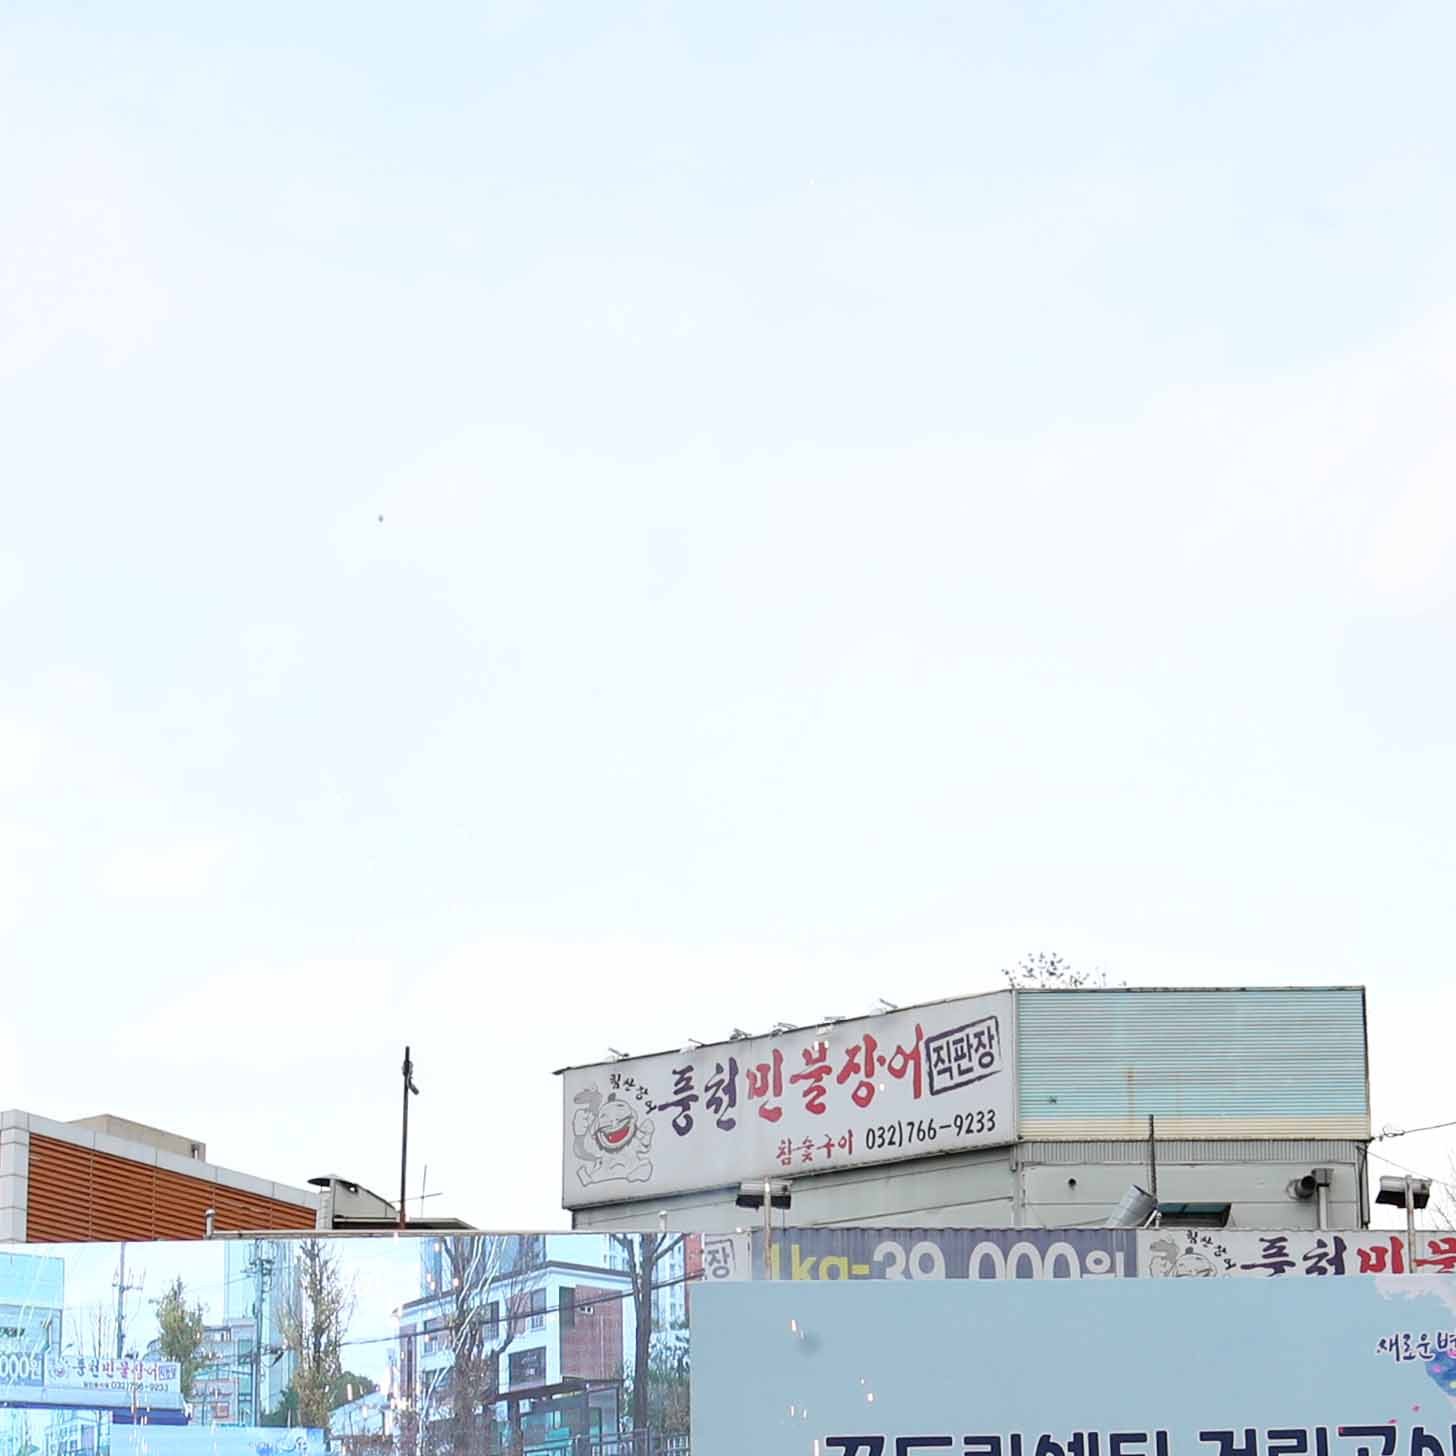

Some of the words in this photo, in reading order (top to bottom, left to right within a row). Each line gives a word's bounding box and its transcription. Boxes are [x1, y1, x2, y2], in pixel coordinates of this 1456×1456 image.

[932, 1026, 995, 1081] 직판장
[776, 1129, 854, 1167] 참숯구이
[865, 1109, 996, 1150] 032)766-9233
[1376, 1333, 1435, 1362] 새로운
